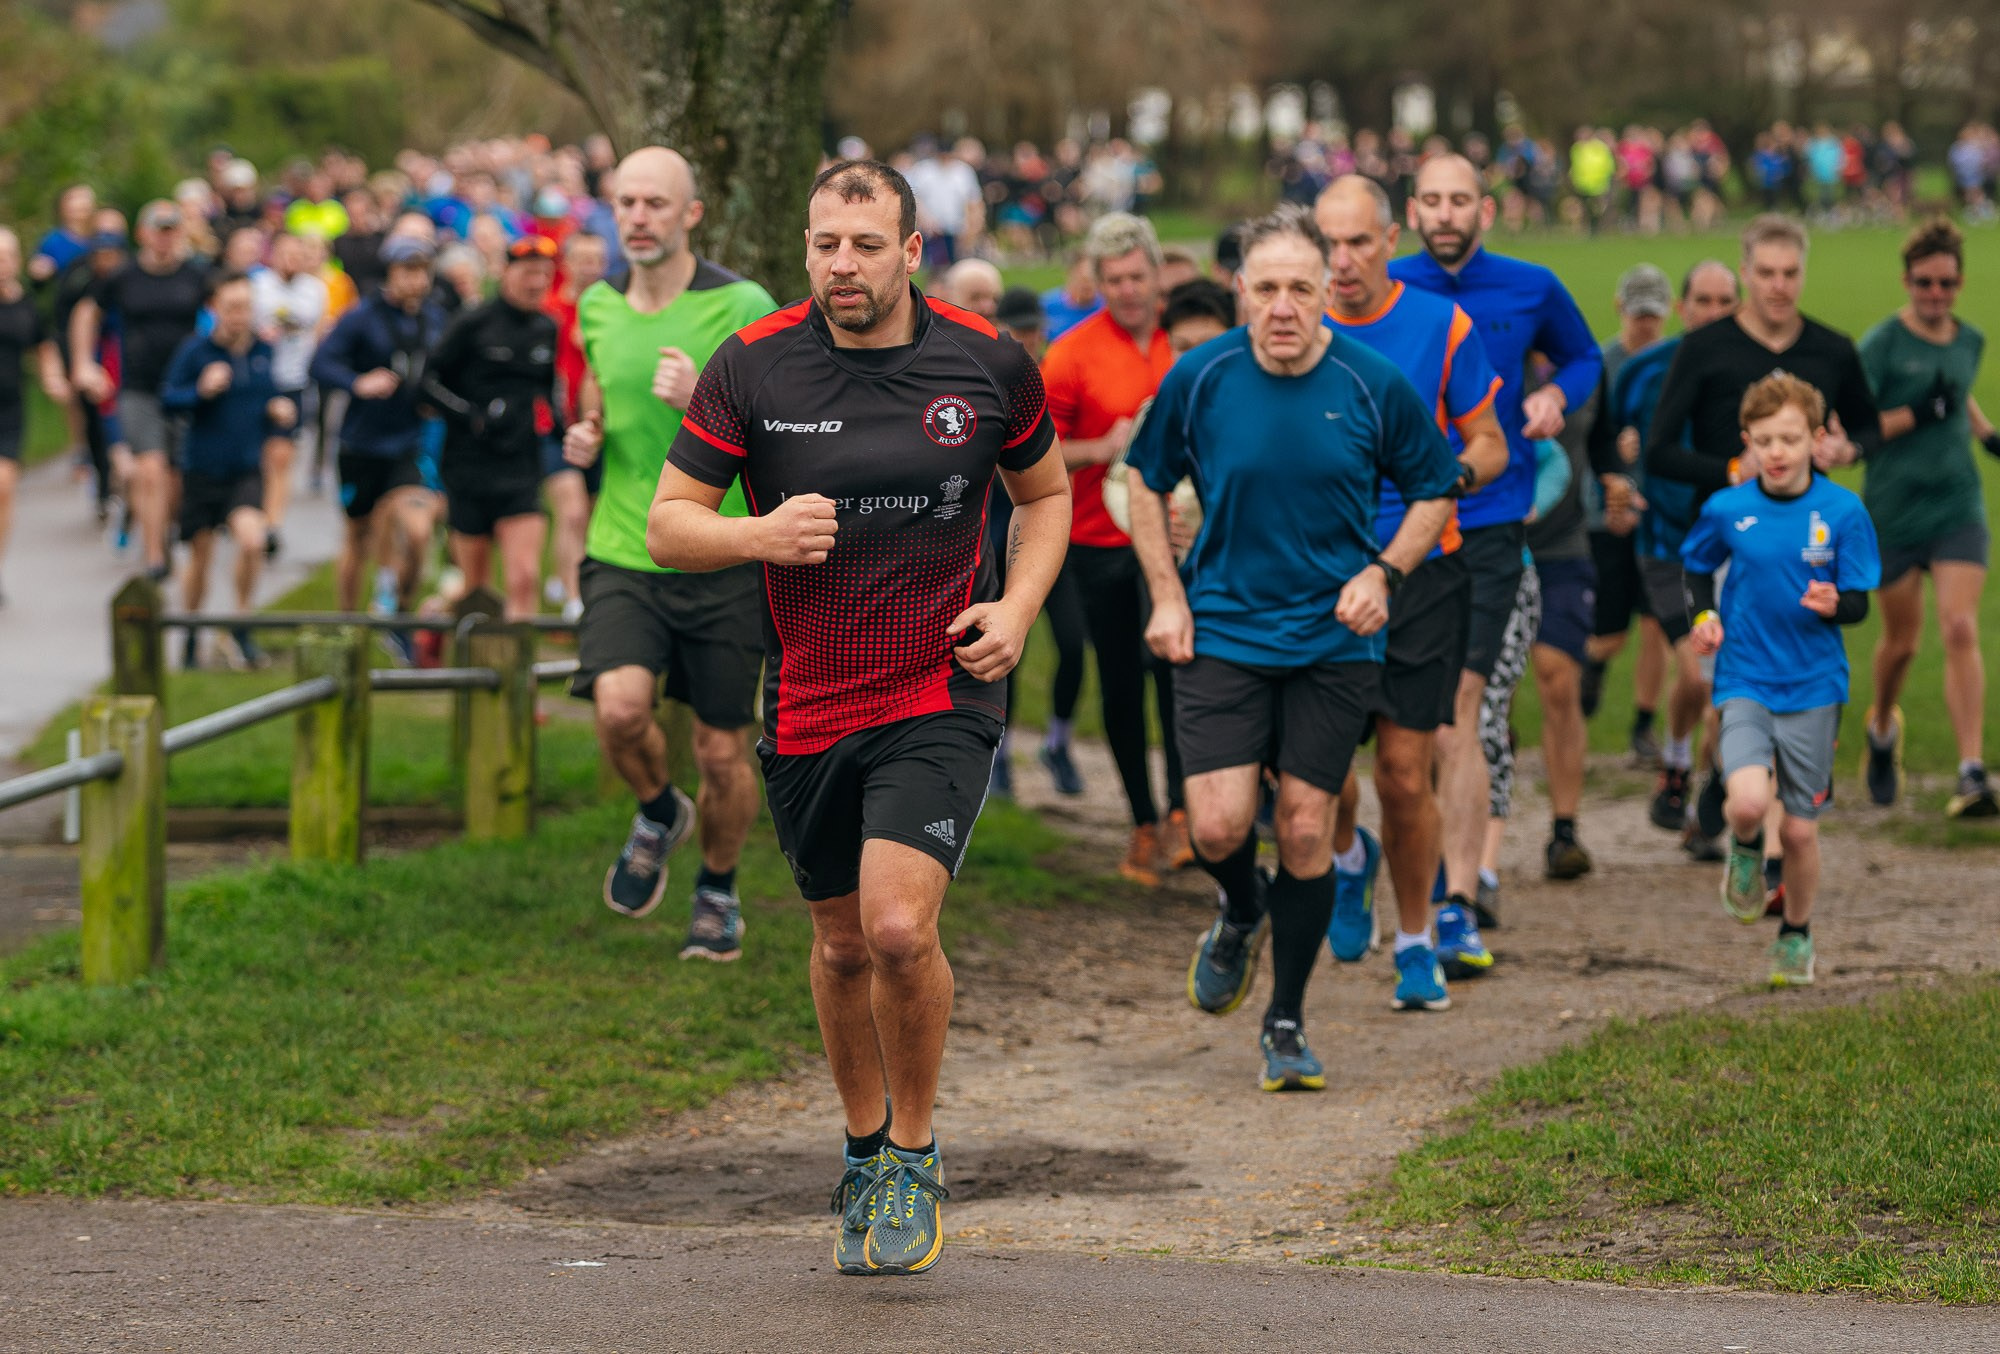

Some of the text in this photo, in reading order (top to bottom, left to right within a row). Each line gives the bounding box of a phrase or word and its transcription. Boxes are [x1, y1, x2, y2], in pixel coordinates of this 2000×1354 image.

[926, 398, 974, 423] BOURNEMOUTH
[939, 434, 967, 445] RUGBY
[859, 495, 929, 514] group
[924, 825, 957, 848] adidas
